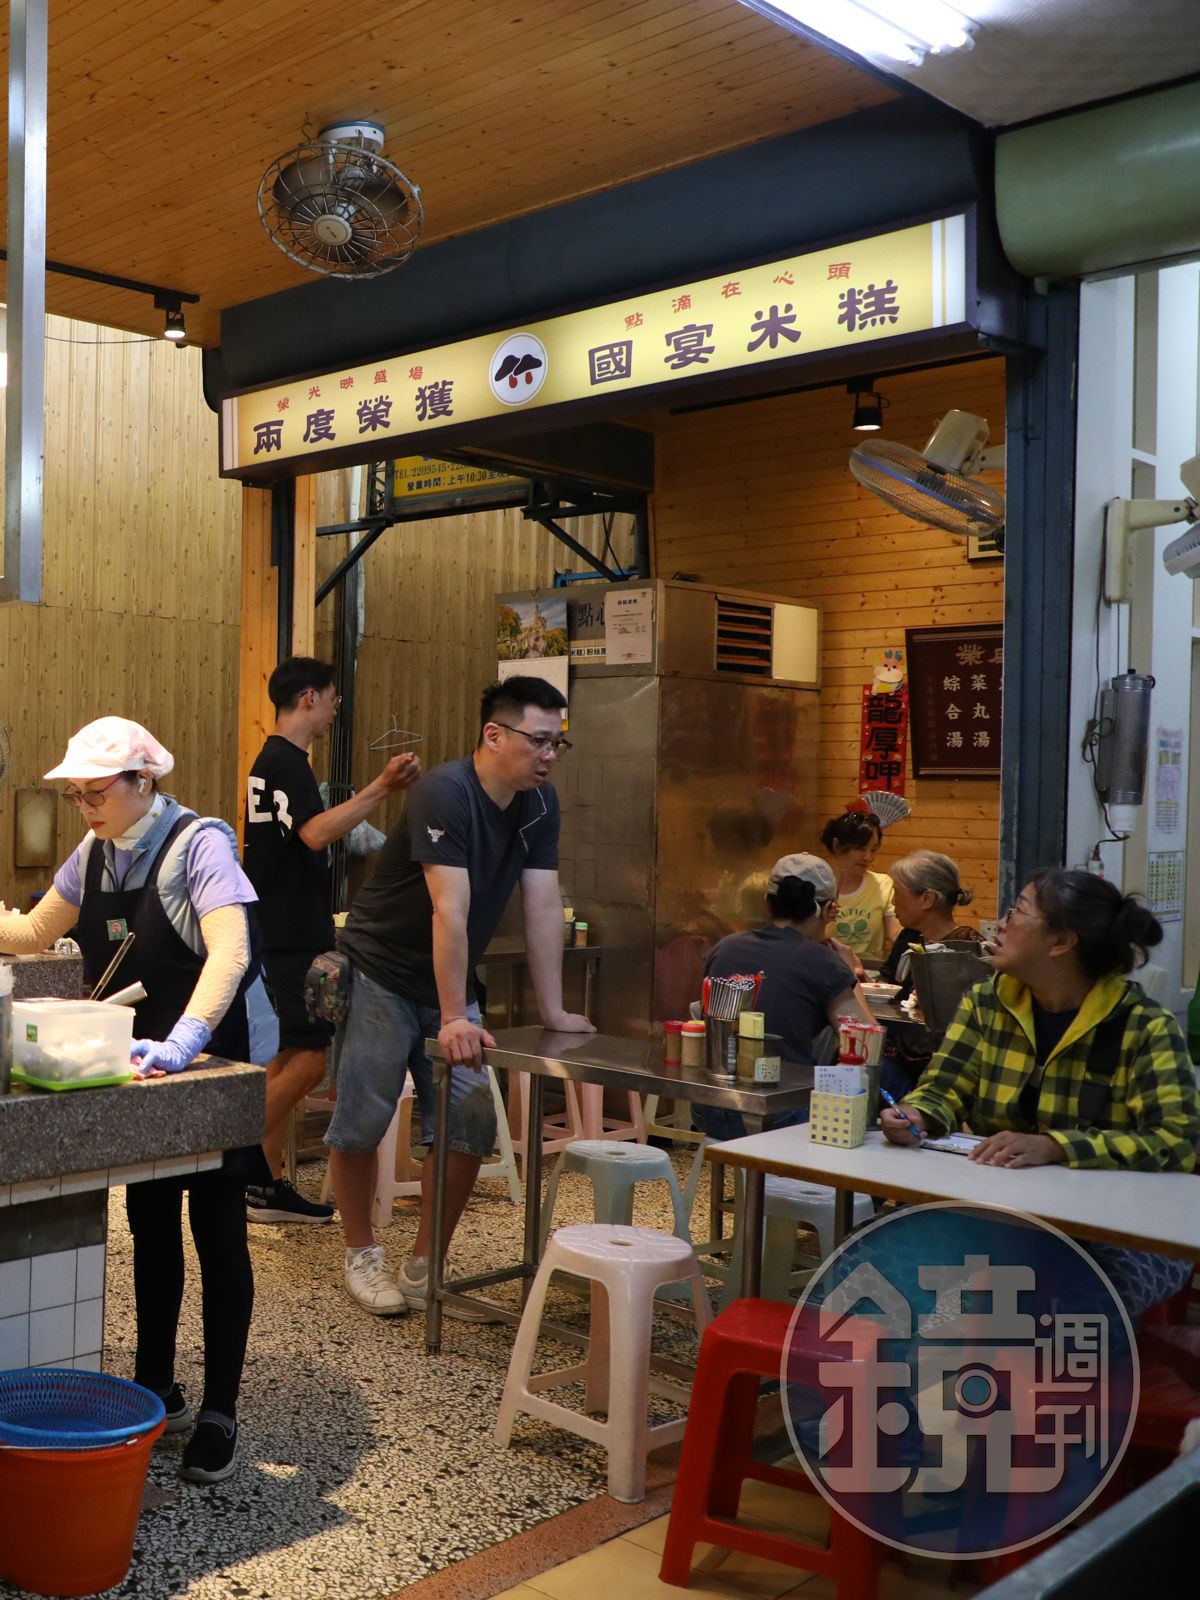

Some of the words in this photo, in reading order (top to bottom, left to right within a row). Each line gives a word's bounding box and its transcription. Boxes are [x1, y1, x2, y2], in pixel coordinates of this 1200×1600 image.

[588, 279, 900, 386] 國宴米糕
[624, 262, 852, 331] 點滴在心頭
[253, 379, 455, 455] 兩度榮獲
[276, 365, 424, 413] 榮光映盛場
[865, 692, 904, 790] 龍厚呷
[970, 674, 991, 749] 菜丸湯
